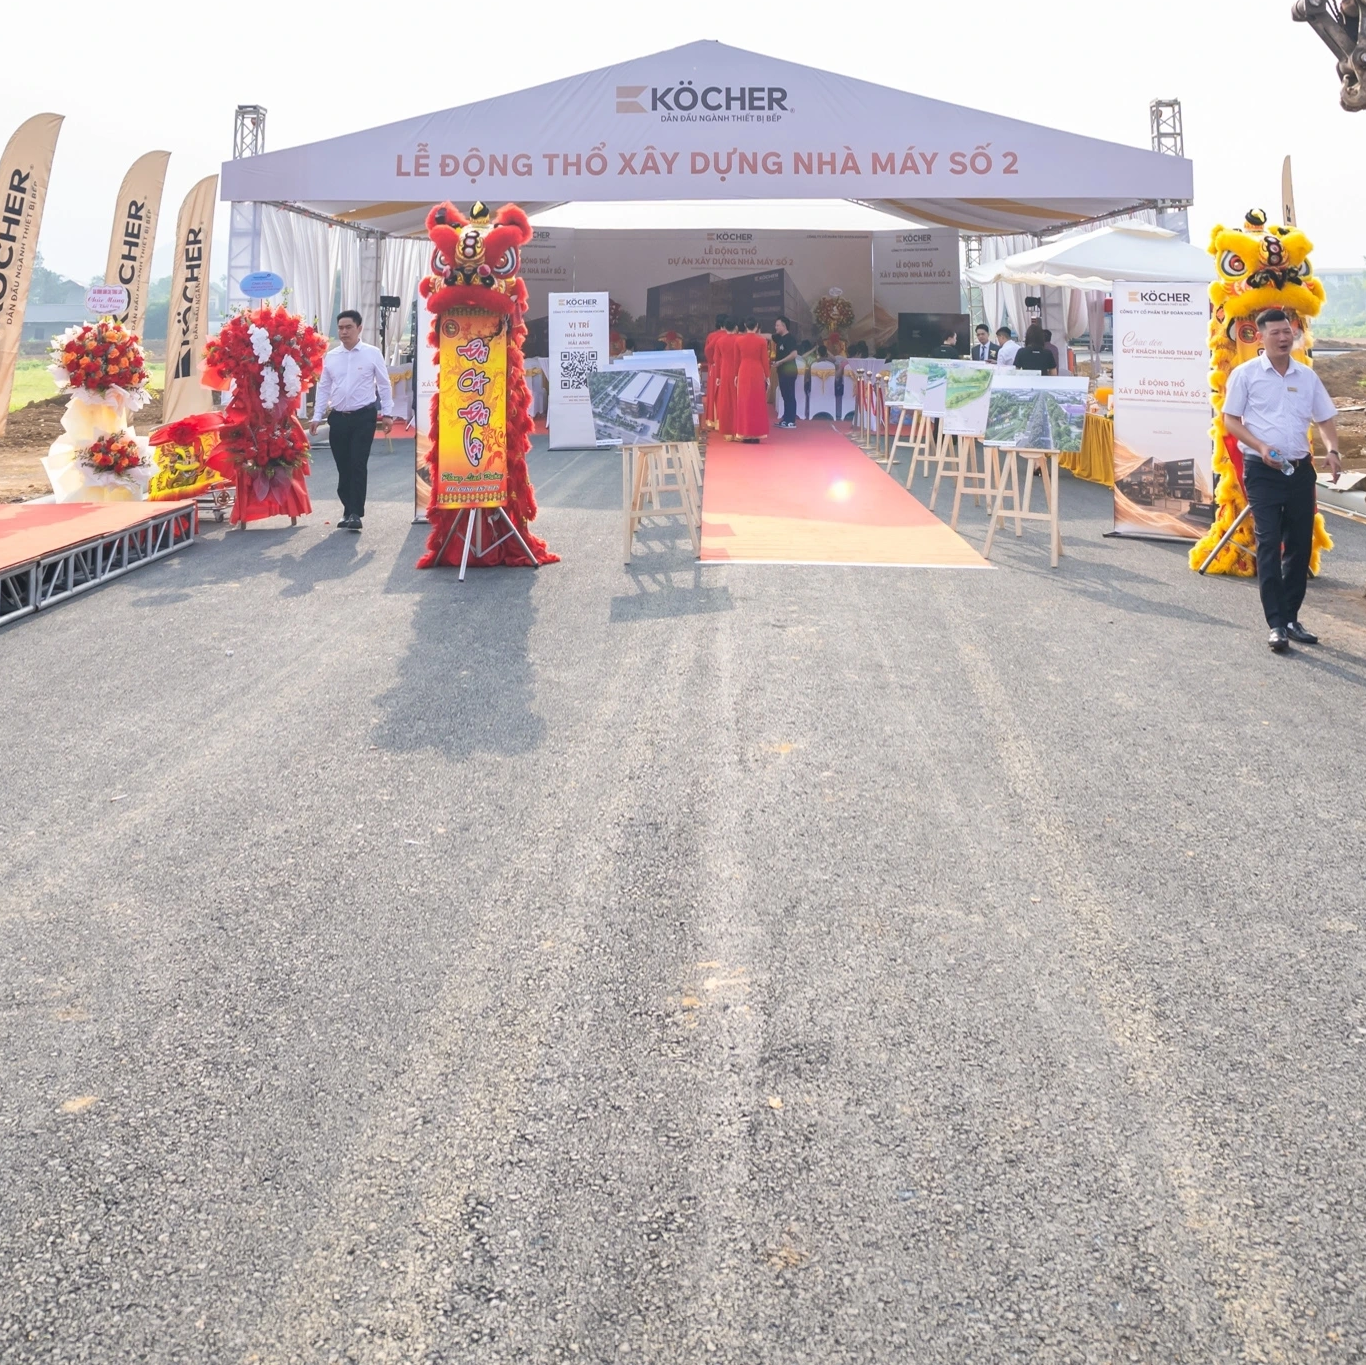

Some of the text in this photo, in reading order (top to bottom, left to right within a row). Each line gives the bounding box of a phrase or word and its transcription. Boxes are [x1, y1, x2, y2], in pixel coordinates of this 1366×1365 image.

[651, 80, 789, 112] KÖCHER
[660, 112, 782, 124] DẪN ĐẦU NGÀNH THIẾT BỊ BẾP
[396, 141, 1019, 184] LỄ ĐỘNG THỔ XÂY DỰNG NHÀ MÁY SỐ 2
[716, 231, 753, 241] KÖCHER
[903, 234, 932, 242] KÖCHER
[789, 258, 794, 266] 2
[1141, 290, 1191, 302] KÖCHER
[566, 298, 597, 306] KÖCHER
[568, 320, 590, 331] VỊ TRÍ
